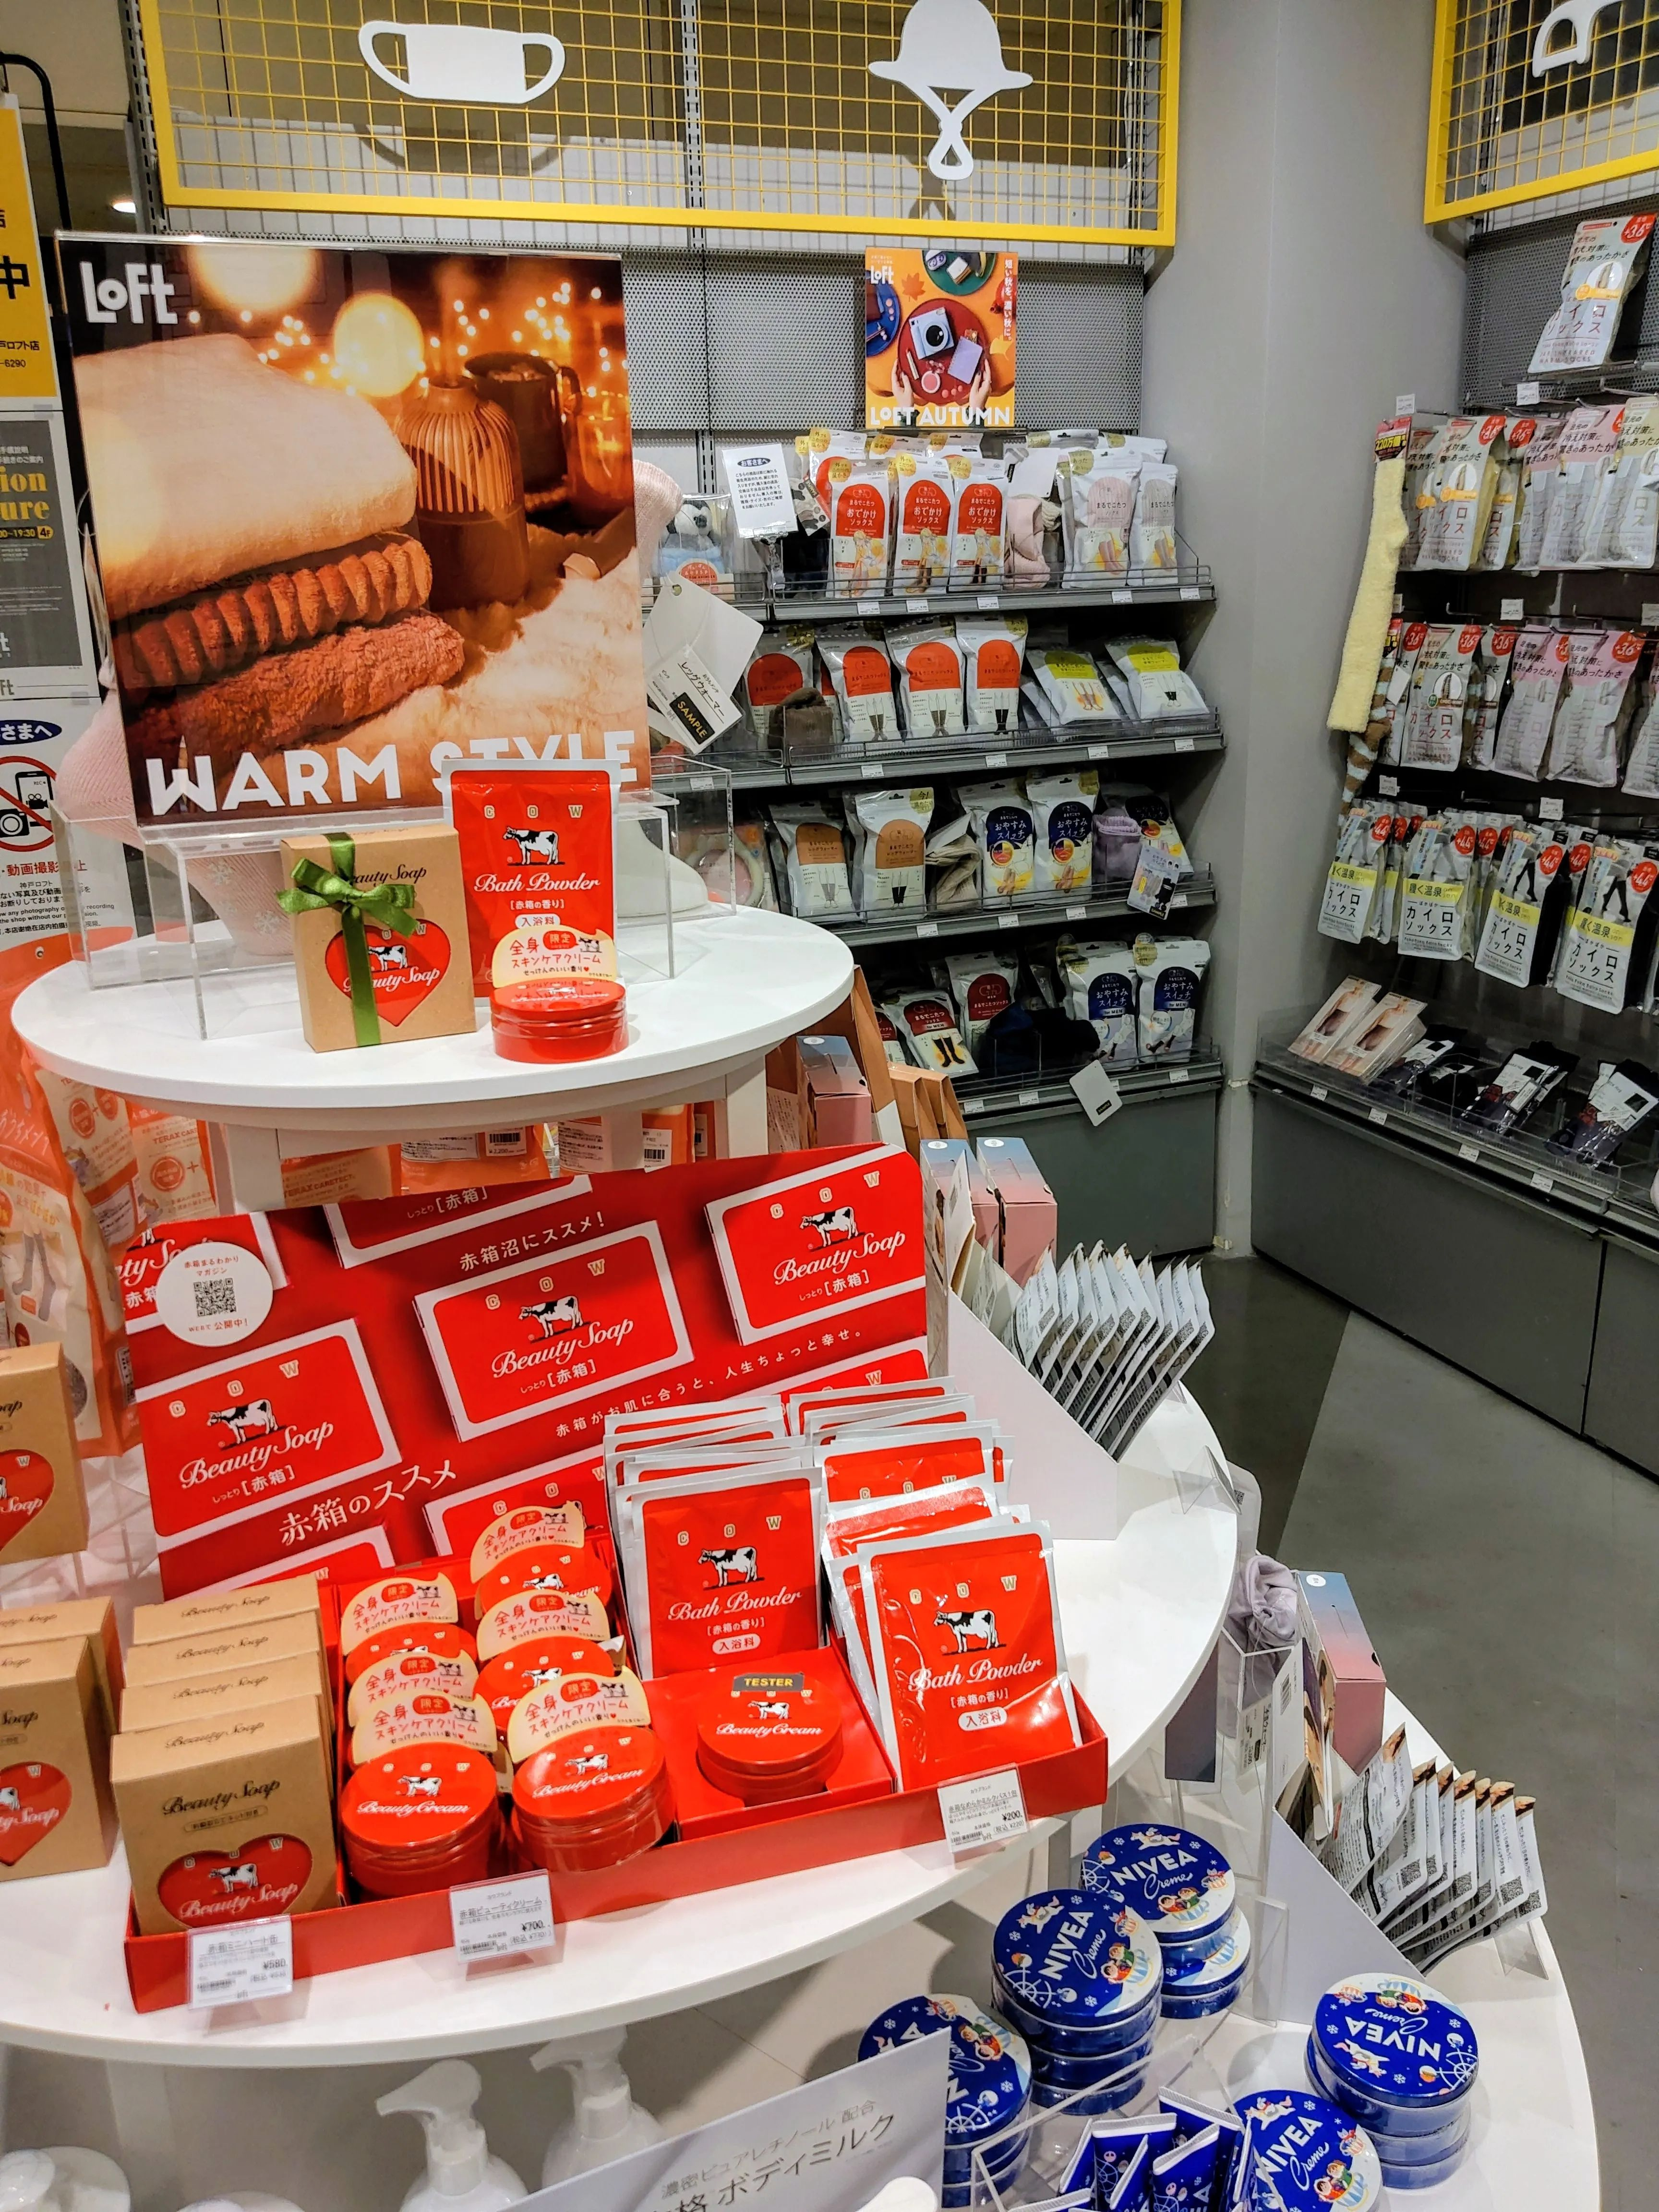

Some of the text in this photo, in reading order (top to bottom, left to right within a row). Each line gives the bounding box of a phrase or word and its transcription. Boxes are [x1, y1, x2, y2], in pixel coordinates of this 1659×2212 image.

[870, 265, 894, 285] Loft
[80, 261, 178, 325] Loft
[870, 407, 1010, 426] LOFT AUTUMN
[847, 508, 877, 518] おでかけ
[850, 518, 873, 527] ソックス
[914, 507, 942, 517] おでかけ
[968, 507, 997, 517] おでかけ
[677, 701, 708, 738] SAMPLE
[146, 745, 400, 816] WARM
[995, 820, 1027, 831] おやすみ
[1057, 817, 1088, 829] おやすみ
[390, 864, 427, 884] Soap
[474, 872, 601, 893] Bath Powder
[21, 907, 60, 915] photography
[510, 898, 565, 910] [赤箱の香り]
[1407, 906, 1454, 924] カイロ
[521, 916, 555, 927] 入浴料
[1406, 920, 1453, 937] ソックス
[509, 937, 540, 956] 全身
[549, 933, 571, 944] 限定
[511, 953, 601, 969] スキンケアクリーム
[1572, 943, 1618, 969] カイロ
[402, 966, 440, 986] Soap
[523, 965, 583, 976] せっけんのいい香り
[1568, 959, 1615, 984] ソックス
[1096, 988, 1129, 999] おやすみ
[1163, 982, 1194, 991] おやすみ
[407, 1187, 488, 1219] しっとり [赤箱]
[459, 1210, 606, 1273] 赤箱沼にススメ!
[184, 1255, 239, 1269] 赤箱まるわかり
[773, 1229, 906, 1286] Beauty Soap
[196, 1267, 228, 1276] マガジン
[798, 1269, 870, 1302] しっとり [赤箱]
[215, 1318, 248, 1330] 公開中!
[491, 1318, 635, 1379] Beauty Soap
[519, 1358, 597, 1394] しっとり [赤箱]
[179, 1420, 335, 1490] Beauty Soap
[211, 1463, 296, 1504] しっとり [赤箱]
[1, 1496, 44, 1515] Soap
[278, 1458, 458, 1547] 赤箱のススメ
[515, 1512, 537, 1524] 限定
[483, 1524, 508, 1550] 全身
[483, 1524, 567, 1560] スキンケアクリーム
[386, 1584, 409, 1598] 限定
[535, 1595, 558, 1609] 限定
[180, 1594, 272, 1618] Beauty Soap
[352, 1595, 379, 1620] 全身
[354, 1600, 440, 1631] スキンケアクリーム
[494, 1603, 525, 1628] 全身
[668, 1587, 804, 1623] Bath Powder
[496, 1614, 591, 1639] スキンケアクリーム
[707, 1616, 766, 1635] [赤箱の香り]
[176, 1635, 269, 1659] Beauty Soap
[718, 1636, 756, 1651] 入浴料
[406, 1659, 430, 1672] 限定
[908, 1656, 1044, 1693] Bath Powder
[173, 1674, 269, 1699] Beauty Soap
[365, 1668, 397, 1692] 全身
[367, 1676, 463, 1704] スキンケアクリーム
[566, 1680, 592, 1695] 限定
[743, 1676, 794, 1688] TESTER
[419, 1697, 445, 1711] 限定
[523, 1694, 559, 1720] 全身
[950, 1687, 1009, 1709] [赤箱の香り]
[373, 1703, 409, 1728] 全身
[528, 1697, 630, 1735] スキンケアクリーム
[965, 1709, 1003, 1727] 入浴料
[165, 1721, 265, 1749] Beauty Soap
[374, 1716, 478, 1741] スキンケアクリーム
[715, 1722, 823, 1739] Beauty Cream
[532, 1767, 644, 1799] Beauty Cream
[163, 1779, 282, 1816] Beauty Soap
[356, 1800, 471, 1816] Beauty Cream
[14, 1806, 60, 1826] Soap
[1110, 1848, 1198, 1887] NIVEA
[1143, 1871, 1193, 1900] Creme
[179, 1881, 300, 1920] Beauty Soap
[1038, 1910, 1095, 1982] NIVEA
[1072, 1928, 1107, 1979] Creme
[1365, 2008, 1429, 2035] Creme
[1343, 2016, 1441, 2062] NIVEA
[660, 2099, 878, 2200] 濃密ピュアレチノール 配合
[1255, 2116, 1324, 2182] NIVEA
[1289, 2141, 1330, 2191] Creme
